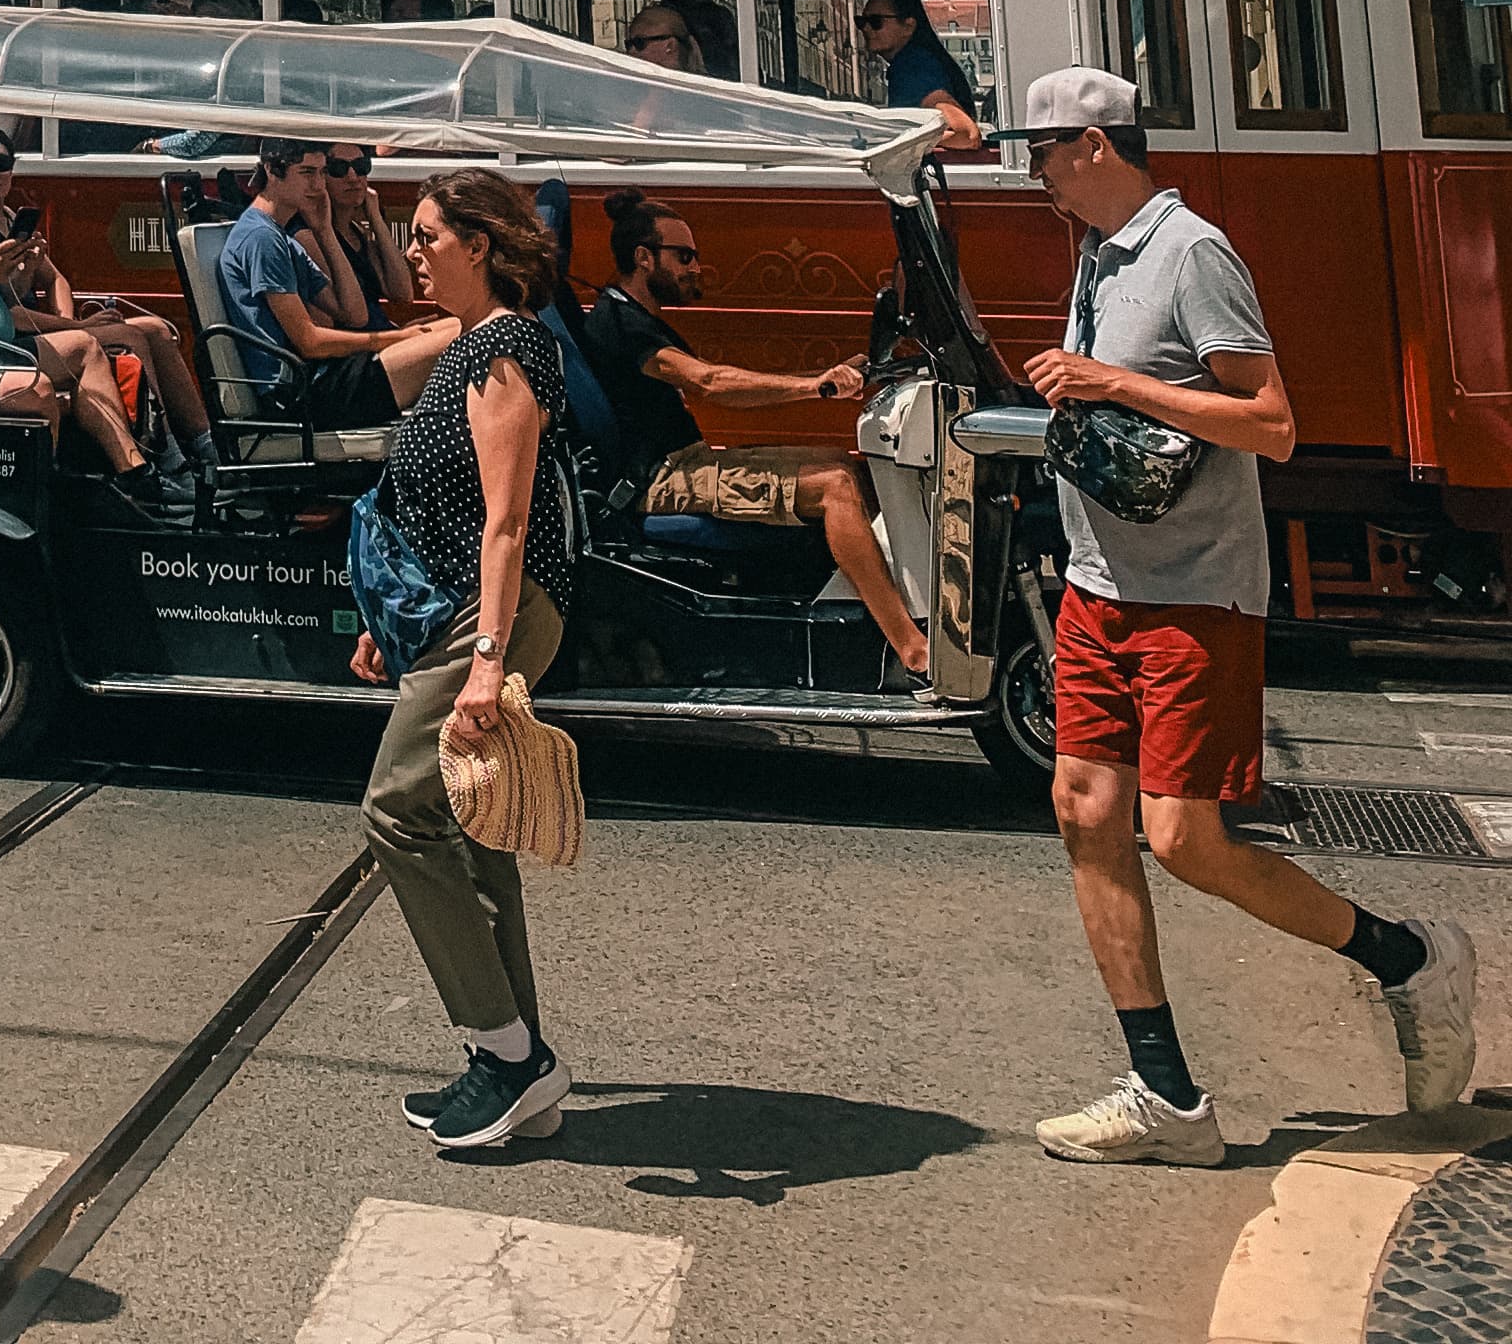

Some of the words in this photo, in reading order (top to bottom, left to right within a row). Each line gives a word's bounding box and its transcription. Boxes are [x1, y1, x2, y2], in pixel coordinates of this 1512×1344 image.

[141, 551, 200, 579] Book
[206, 562, 261, 586] your
[266, 560, 315, 585] tour
[323, 559, 352, 587] he
[156, 604, 320, 628] www.itookatuktuk.com
